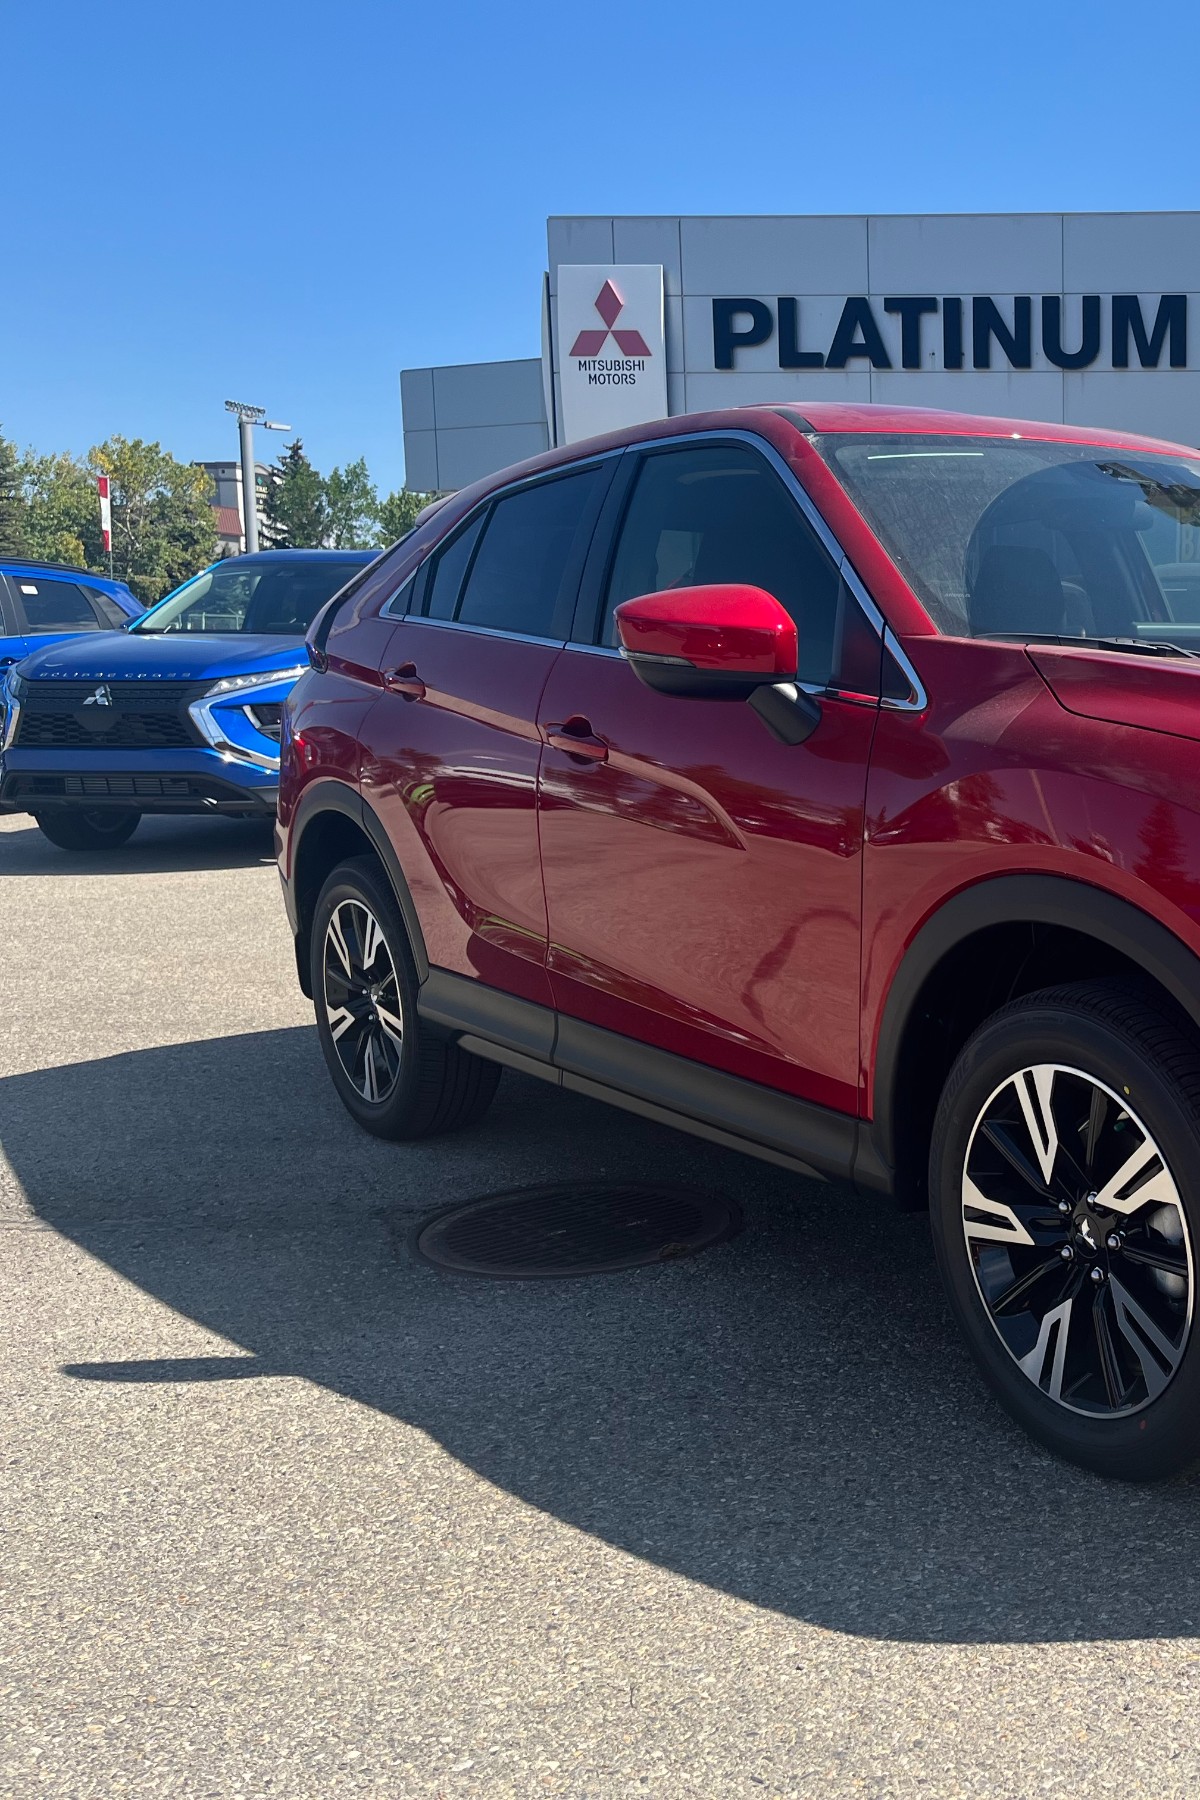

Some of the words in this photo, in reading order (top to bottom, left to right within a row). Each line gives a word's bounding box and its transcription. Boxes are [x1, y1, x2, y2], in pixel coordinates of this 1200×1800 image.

[712, 294, 1188, 370] PLATINUM
[578, 359, 645, 372] MITSUBISHI
[588, 373, 636, 385] MOTORS
